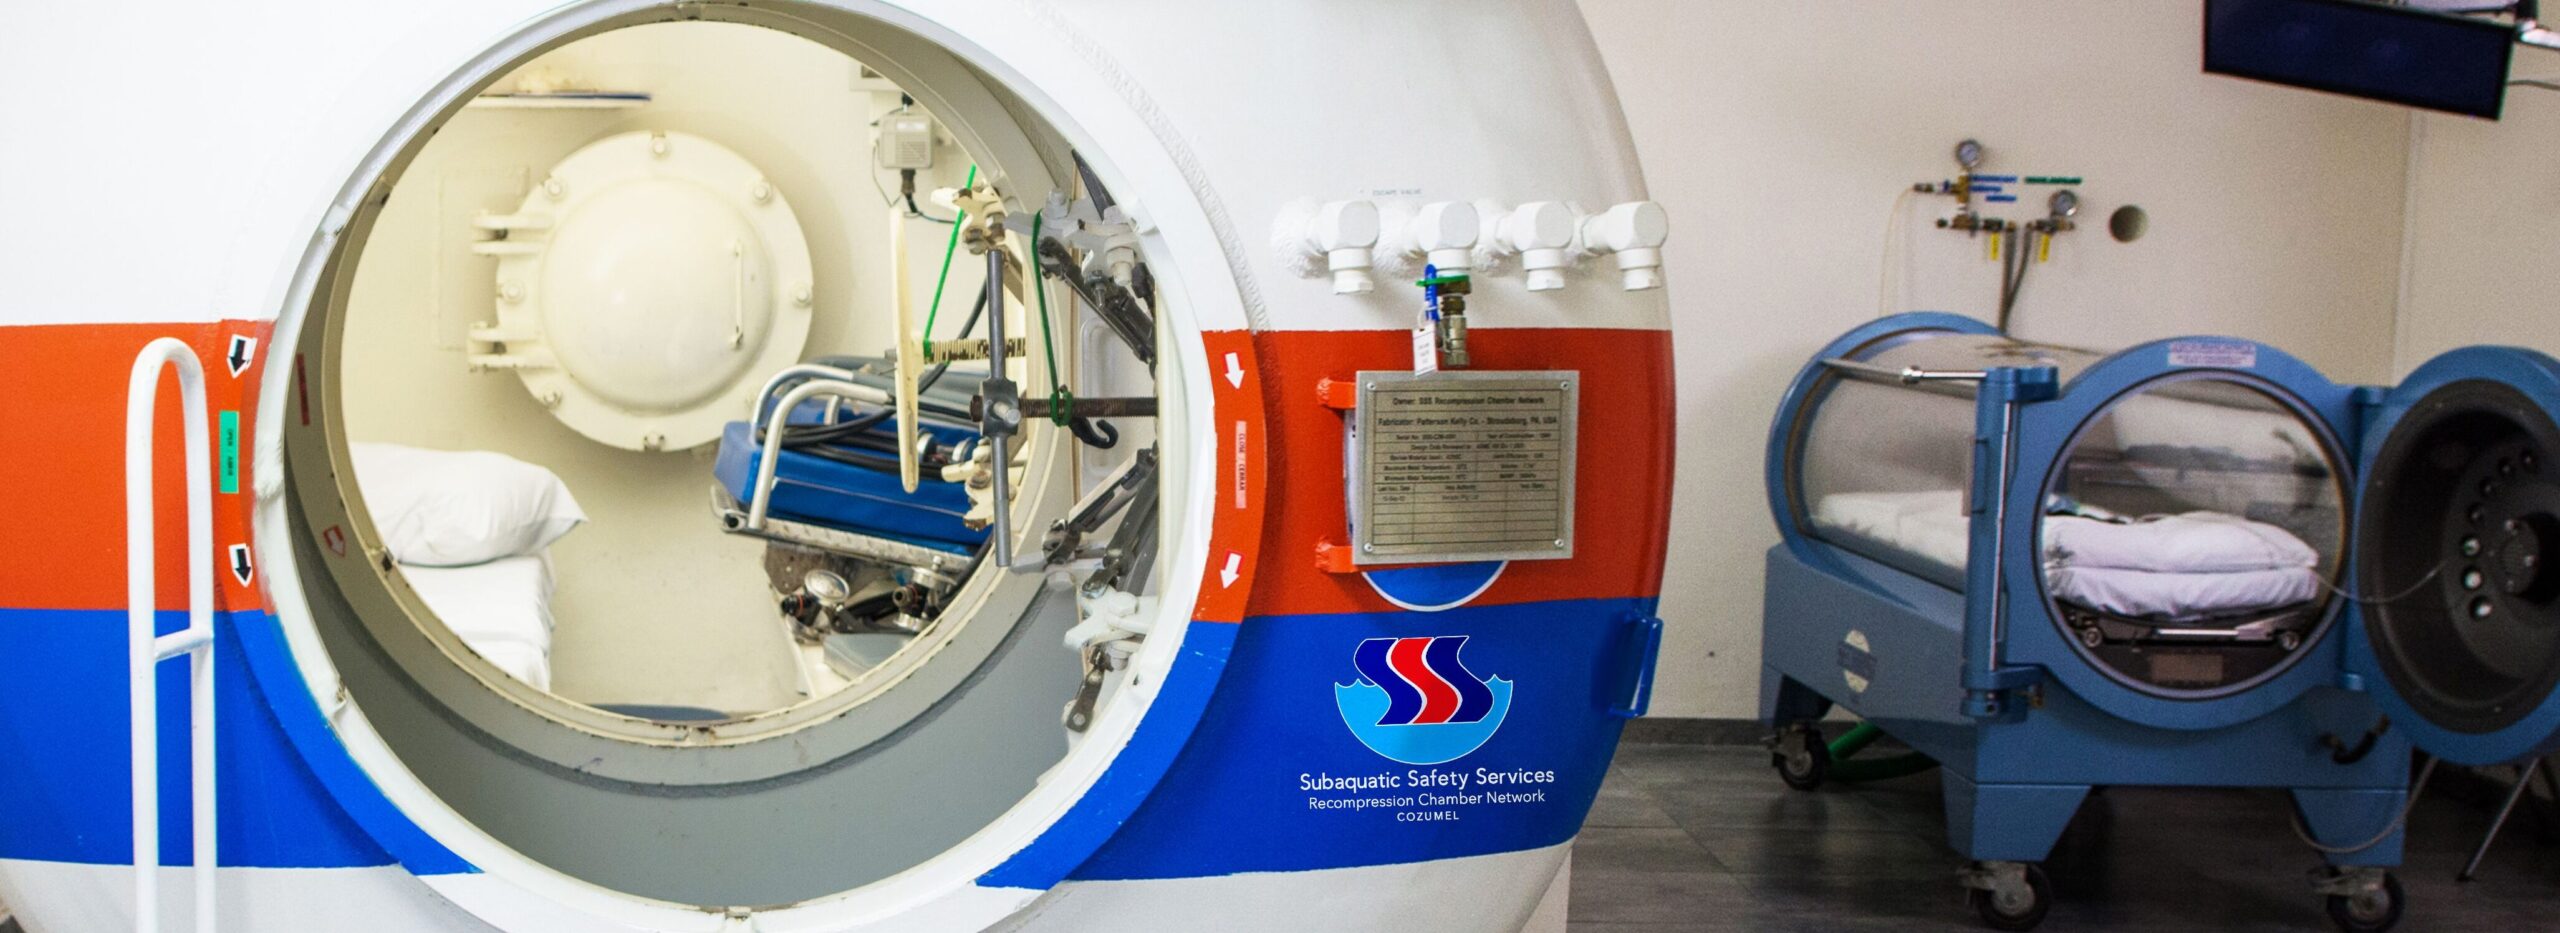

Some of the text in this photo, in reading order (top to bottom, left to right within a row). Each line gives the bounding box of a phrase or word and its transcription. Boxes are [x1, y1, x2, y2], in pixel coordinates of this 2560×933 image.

[1487, 396, 1516, 404] Chamber
[1518, 396, 1544, 404] Network
[1354, 635, 1494, 727] SSS
[1300, 767, 1555, 794] Subaquatic Safety Services
[1309, 788, 1546, 812] Recompression Chamber Network
[1396, 811, 1460, 822] COZUMEL
